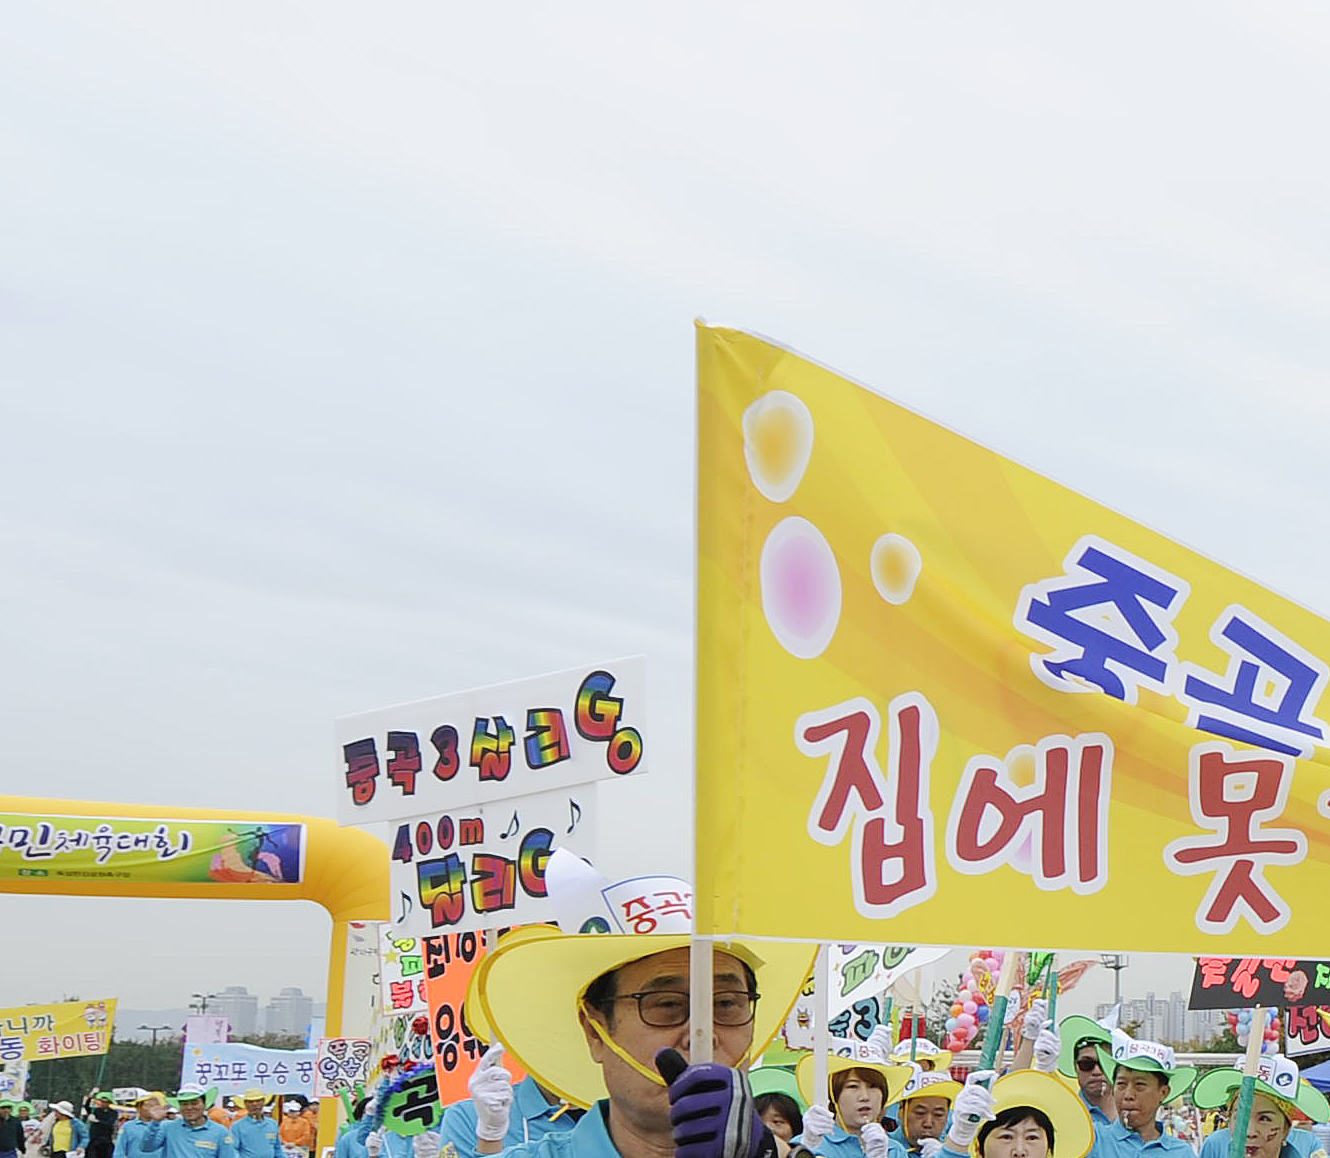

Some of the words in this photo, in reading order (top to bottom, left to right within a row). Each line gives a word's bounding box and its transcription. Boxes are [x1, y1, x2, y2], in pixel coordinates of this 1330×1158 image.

[804, 705, 1104, 906] 집에
[1173, 751, 1298, 923] 못
[0, 824, 189, 862] 민체육대회
[392, 815, 484, 863] 400m
[416, 828, 552, 928] 달리G
[621, 892, 692, 934] 중곡
[0, 1015, 54, 1036] 니까
[37, 1031, 106, 1055] 화이팅!
[196, 1062, 247, 1085] 꿍꼬또
[254, 1061, 289, 1084] 우승
